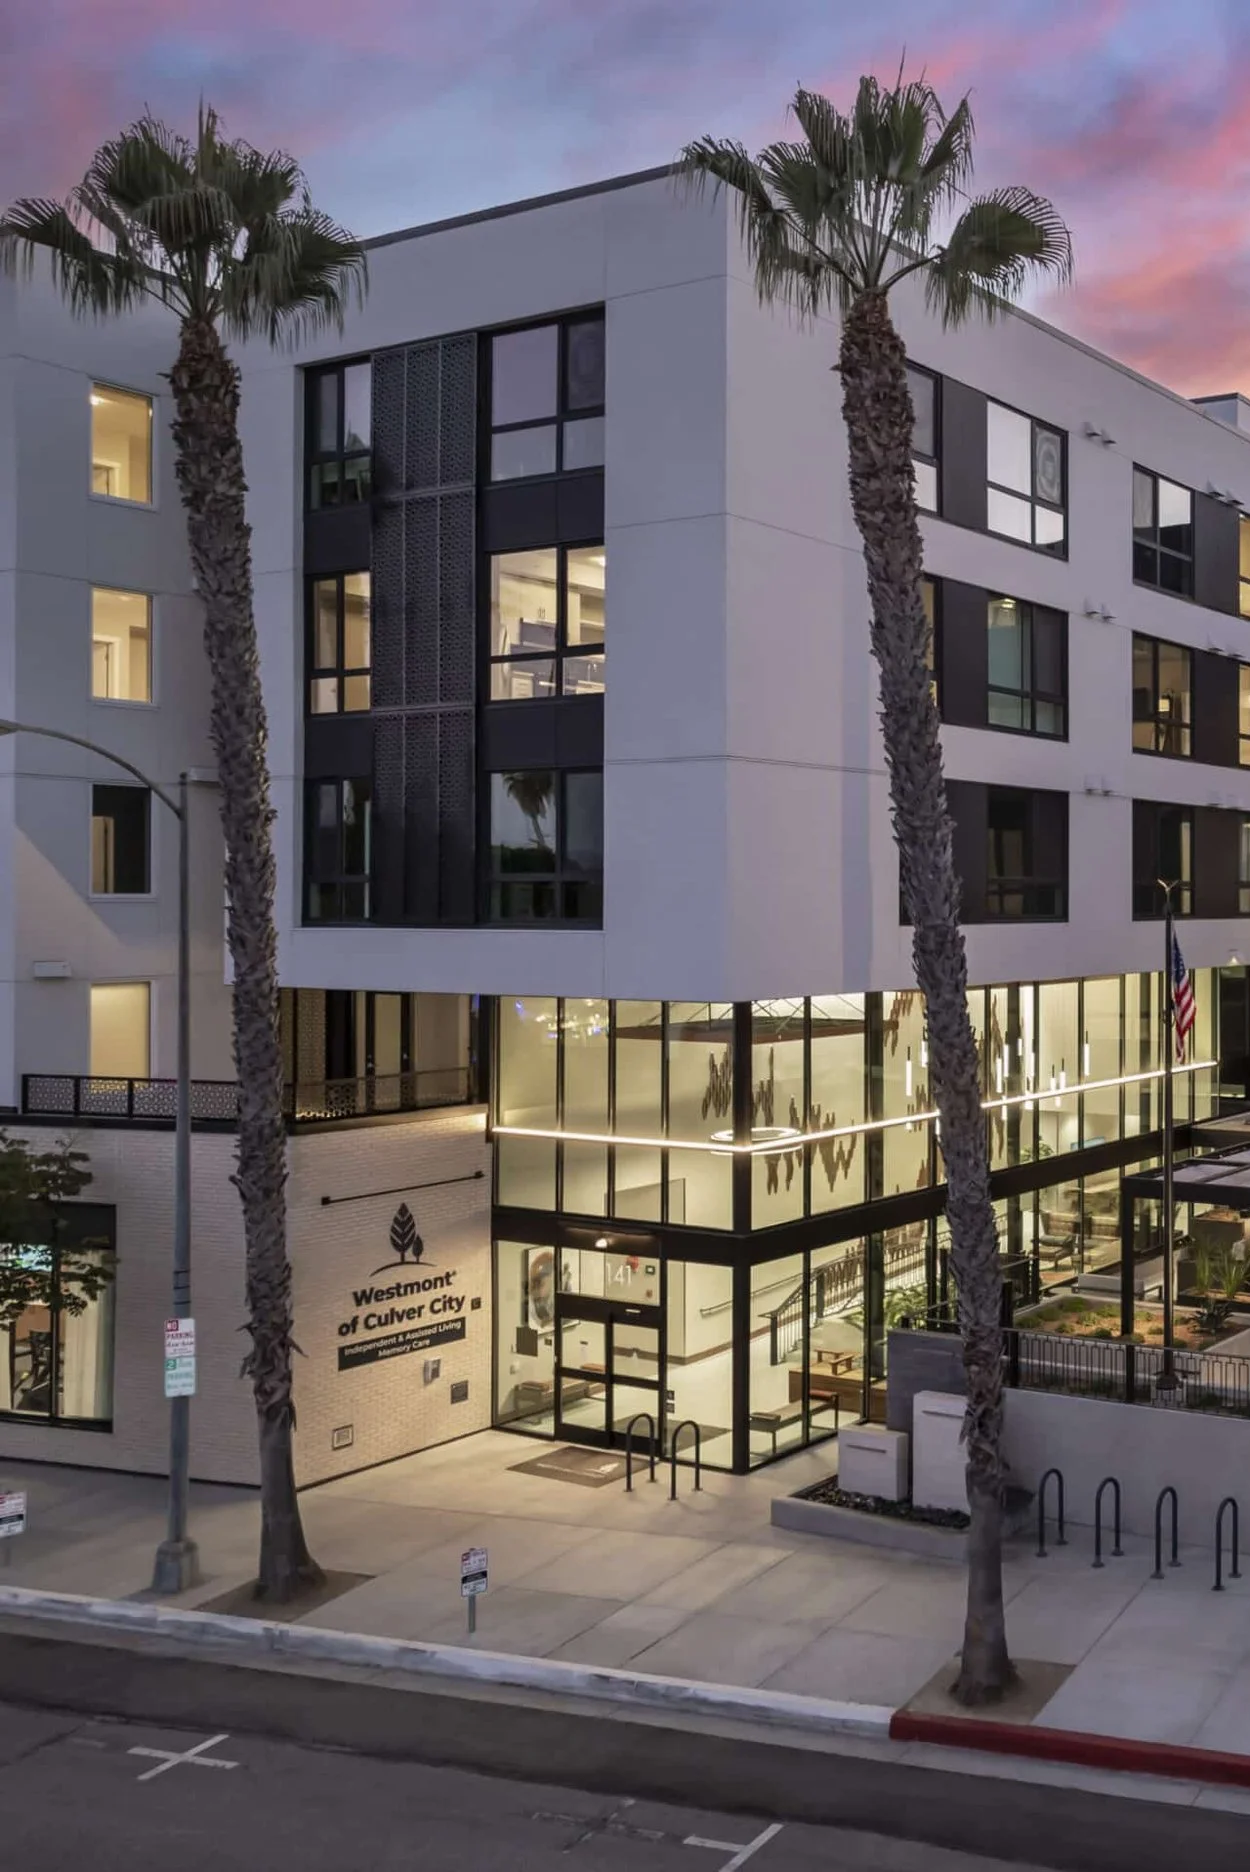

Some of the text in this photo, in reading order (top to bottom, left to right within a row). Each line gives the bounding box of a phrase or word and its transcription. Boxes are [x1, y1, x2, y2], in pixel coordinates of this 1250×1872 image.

[352, 1270, 454, 1308] Westmont
[338, 1294, 466, 1336] of Culver City
[344, 1320, 462, 1356] Independent & Assisted Living
[378, 1339, 431, 1357] Memory Care
